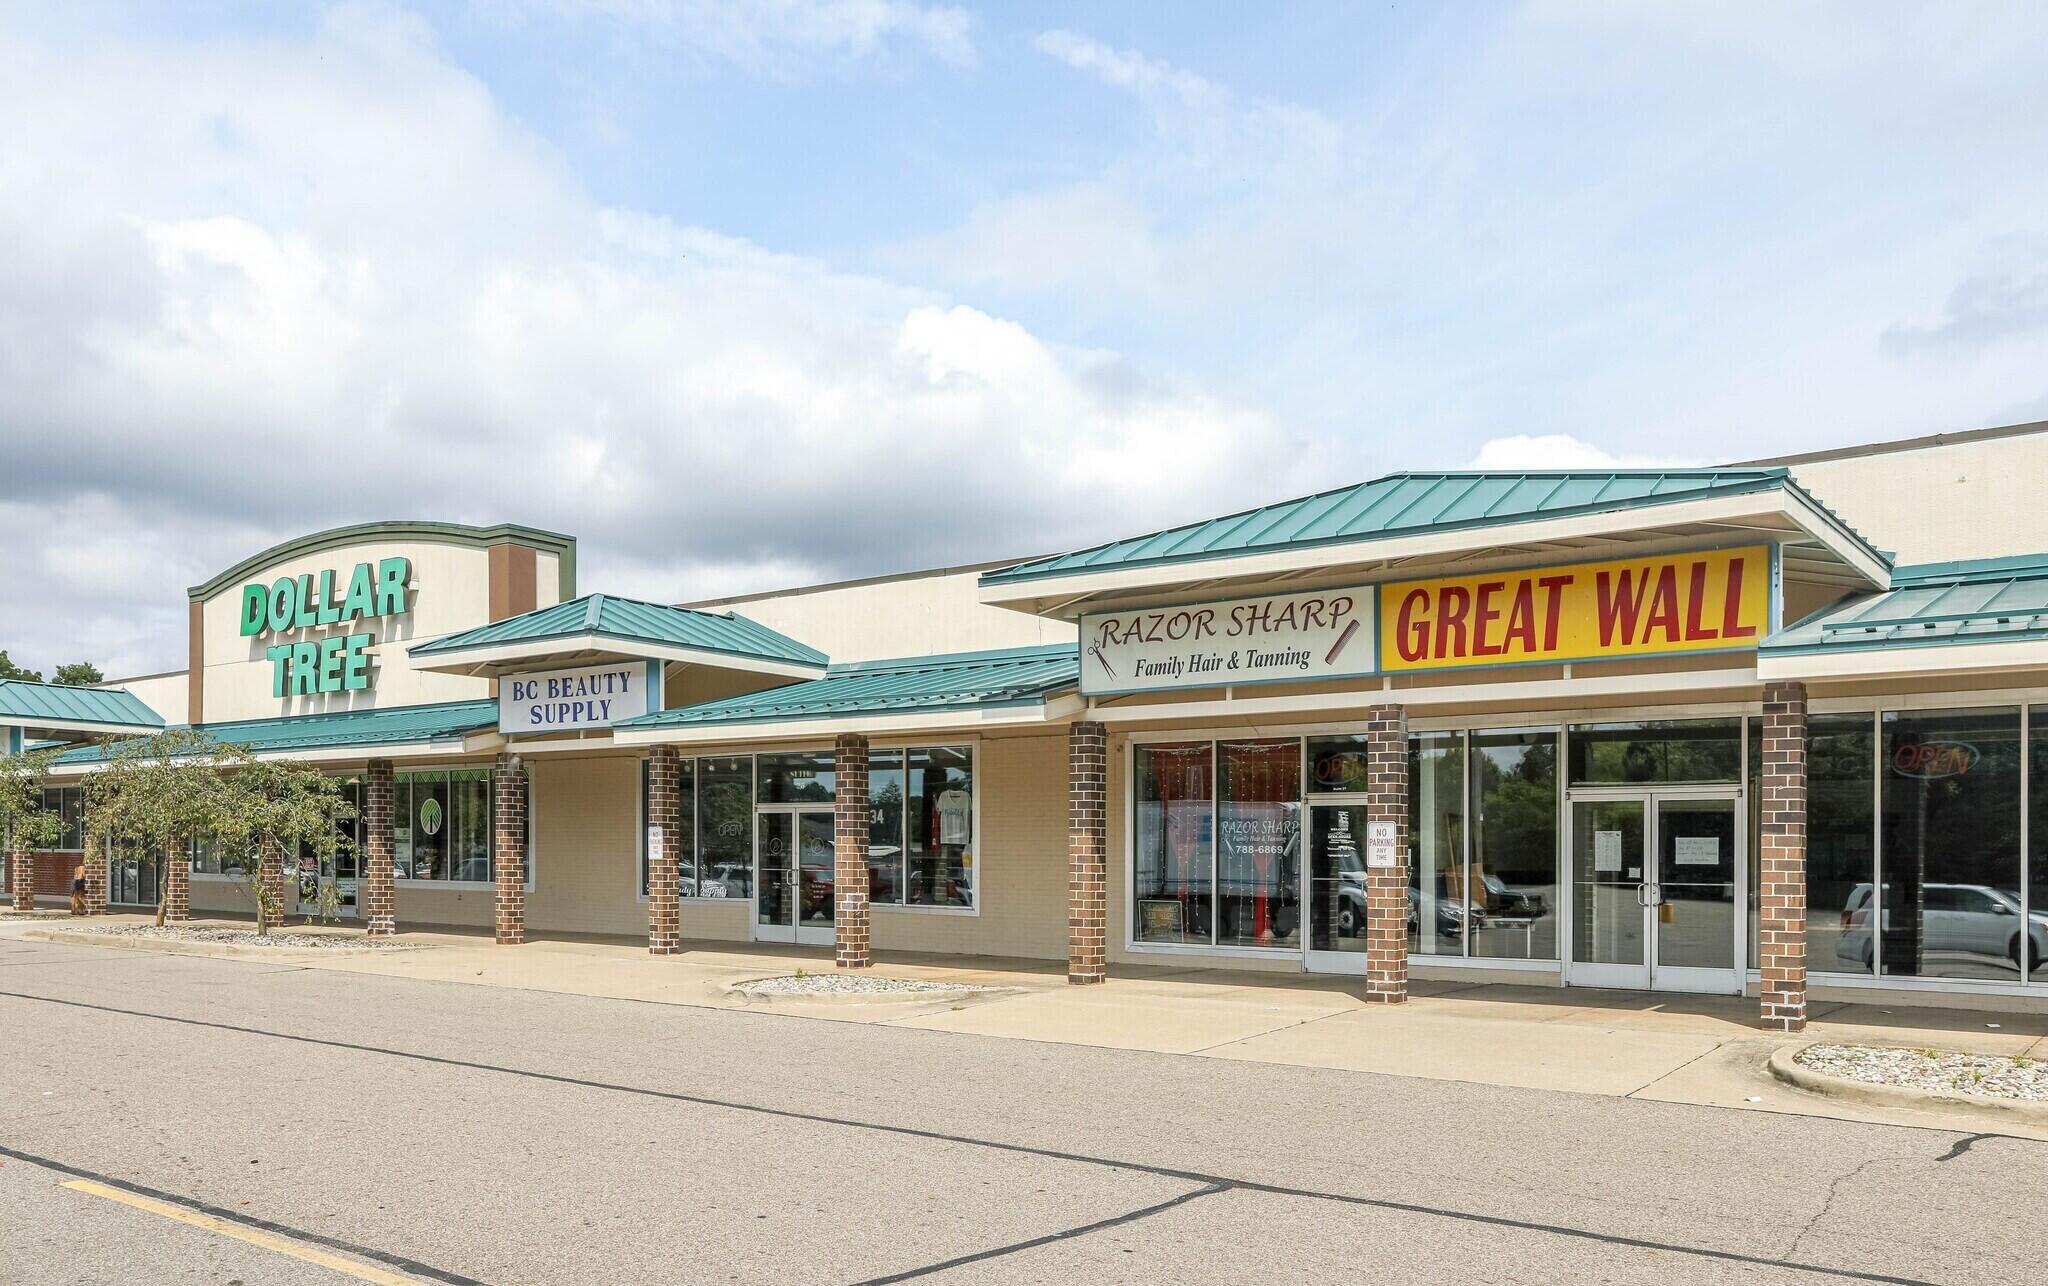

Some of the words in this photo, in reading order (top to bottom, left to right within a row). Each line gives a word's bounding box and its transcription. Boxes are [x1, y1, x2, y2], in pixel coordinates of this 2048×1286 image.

[240, 557, 412, 636] DOLLAR
[1397, 575, 1573, 662] GREAT
[1596, 558, 1757, 646] WALL
[1100, 609, 1217, 648] RAZOR
[1227, 597, 1354, 636] SHARP
[266, 633, 375, 698] TREE
[1135, 656, 1184, 678] Family
[1188, 653, 1223, 673] Hair
[1227, 650, 1239, 670] &
[1246, 645, 1311, 669] Tanning
[513, 680, 538, 701] BC
[548, 671, 631, 699] BEAUTY
[530, 699, 612, 725] SUPPLY
[1894, 744, 1971, 775] OPEN
[719, 824, 743, 837] OPEN
[1221, 820, 1258, 835] RAZOR
[1261, 818, 1300, 835] SHARP
[1376, 828, 1387, 837] NO
[1236, 845, 1284, 854] 788-6869
[1369, 838, 1395, 847] PARKING
